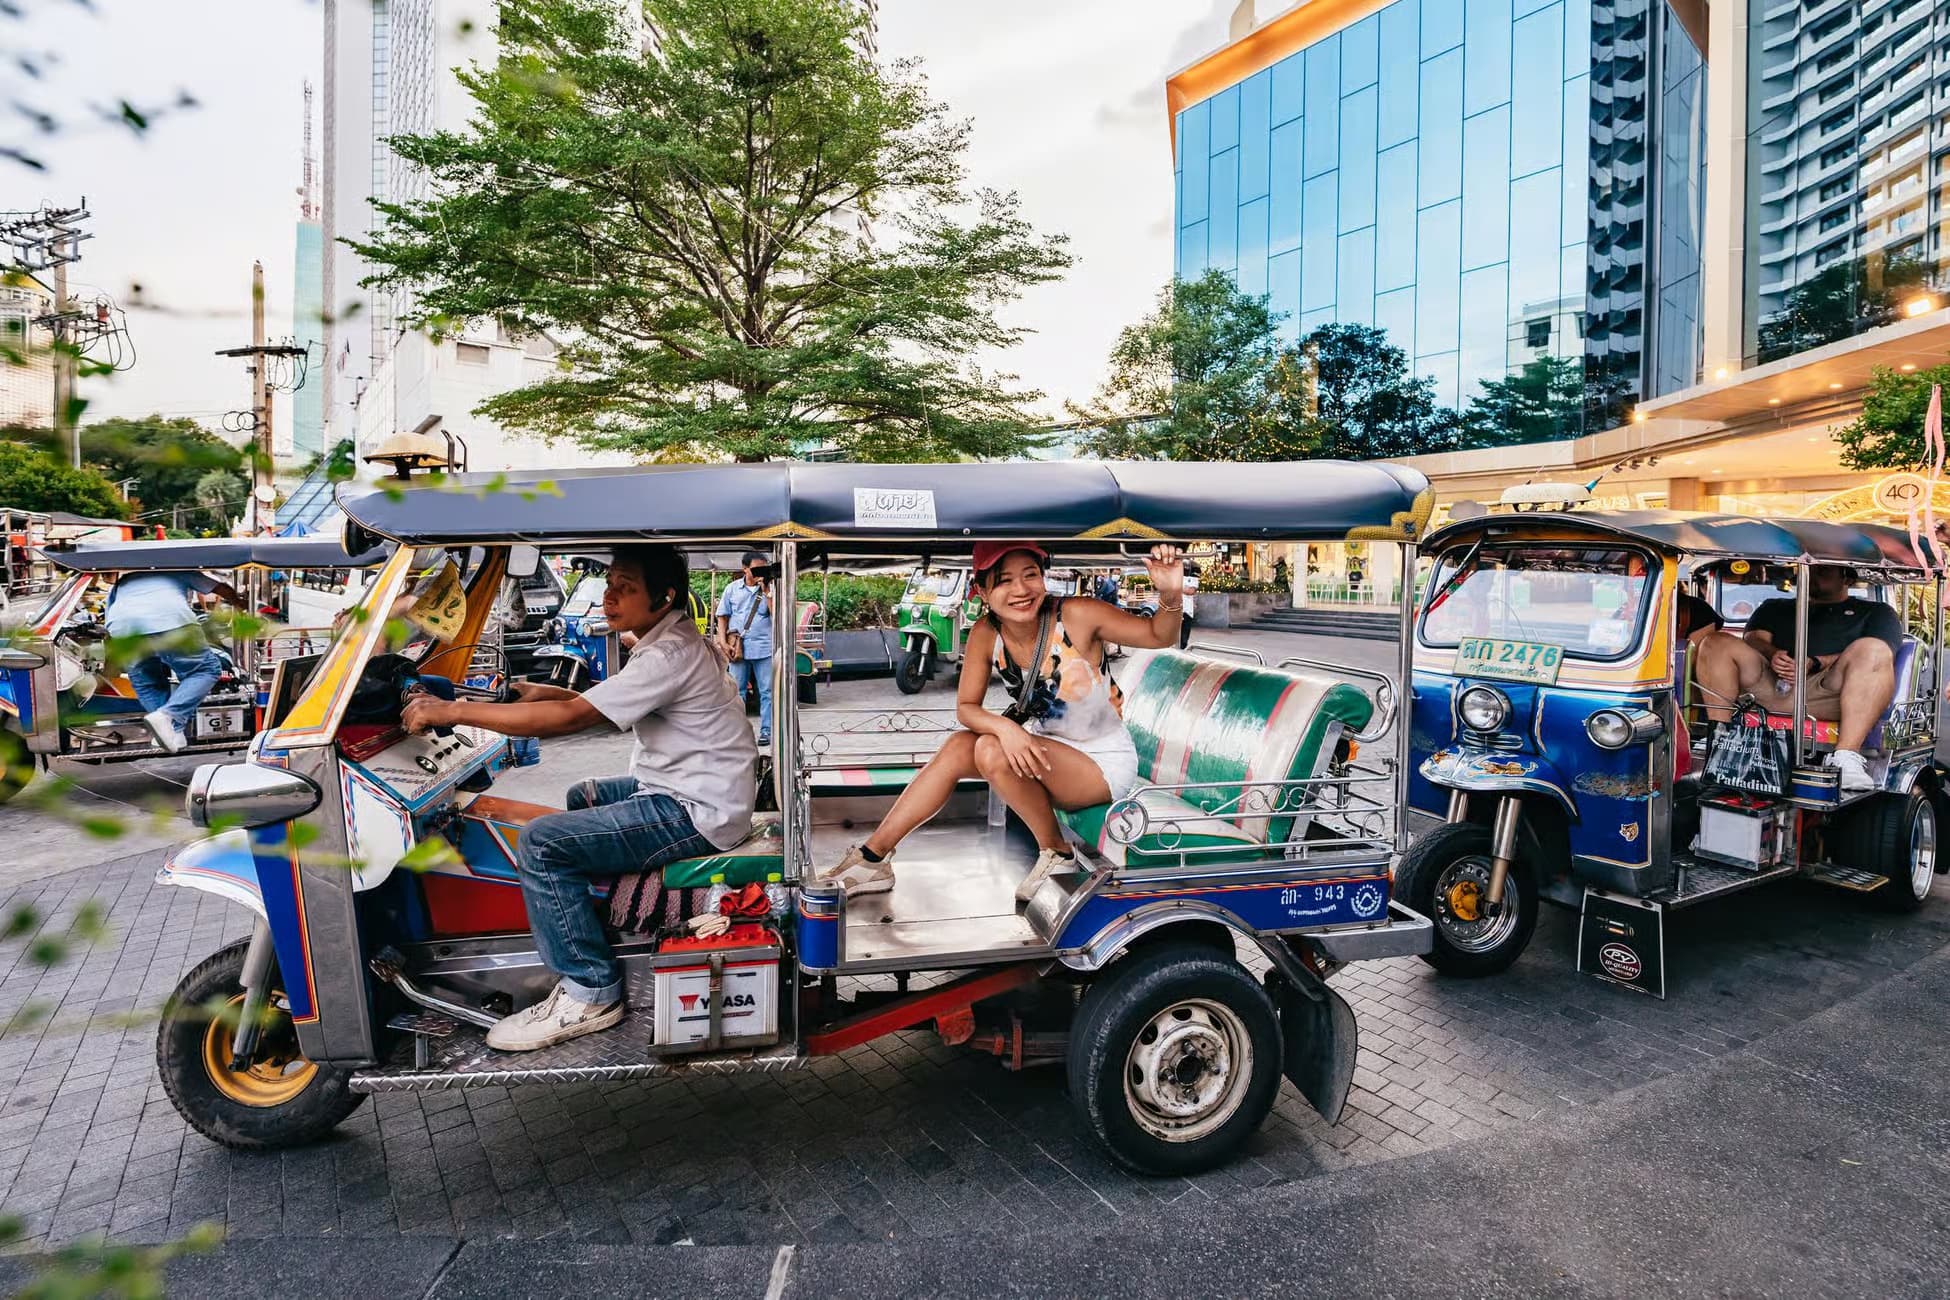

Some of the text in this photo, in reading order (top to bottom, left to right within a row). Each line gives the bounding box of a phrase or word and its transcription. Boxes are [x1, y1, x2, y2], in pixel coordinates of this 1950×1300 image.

[1499, 643, 1559, 667] 2476
[1716, 773, 1782, 794] Palladium
[1314, 885, 1344, 901] 943
[700, 994, 755, 1009] YASA
